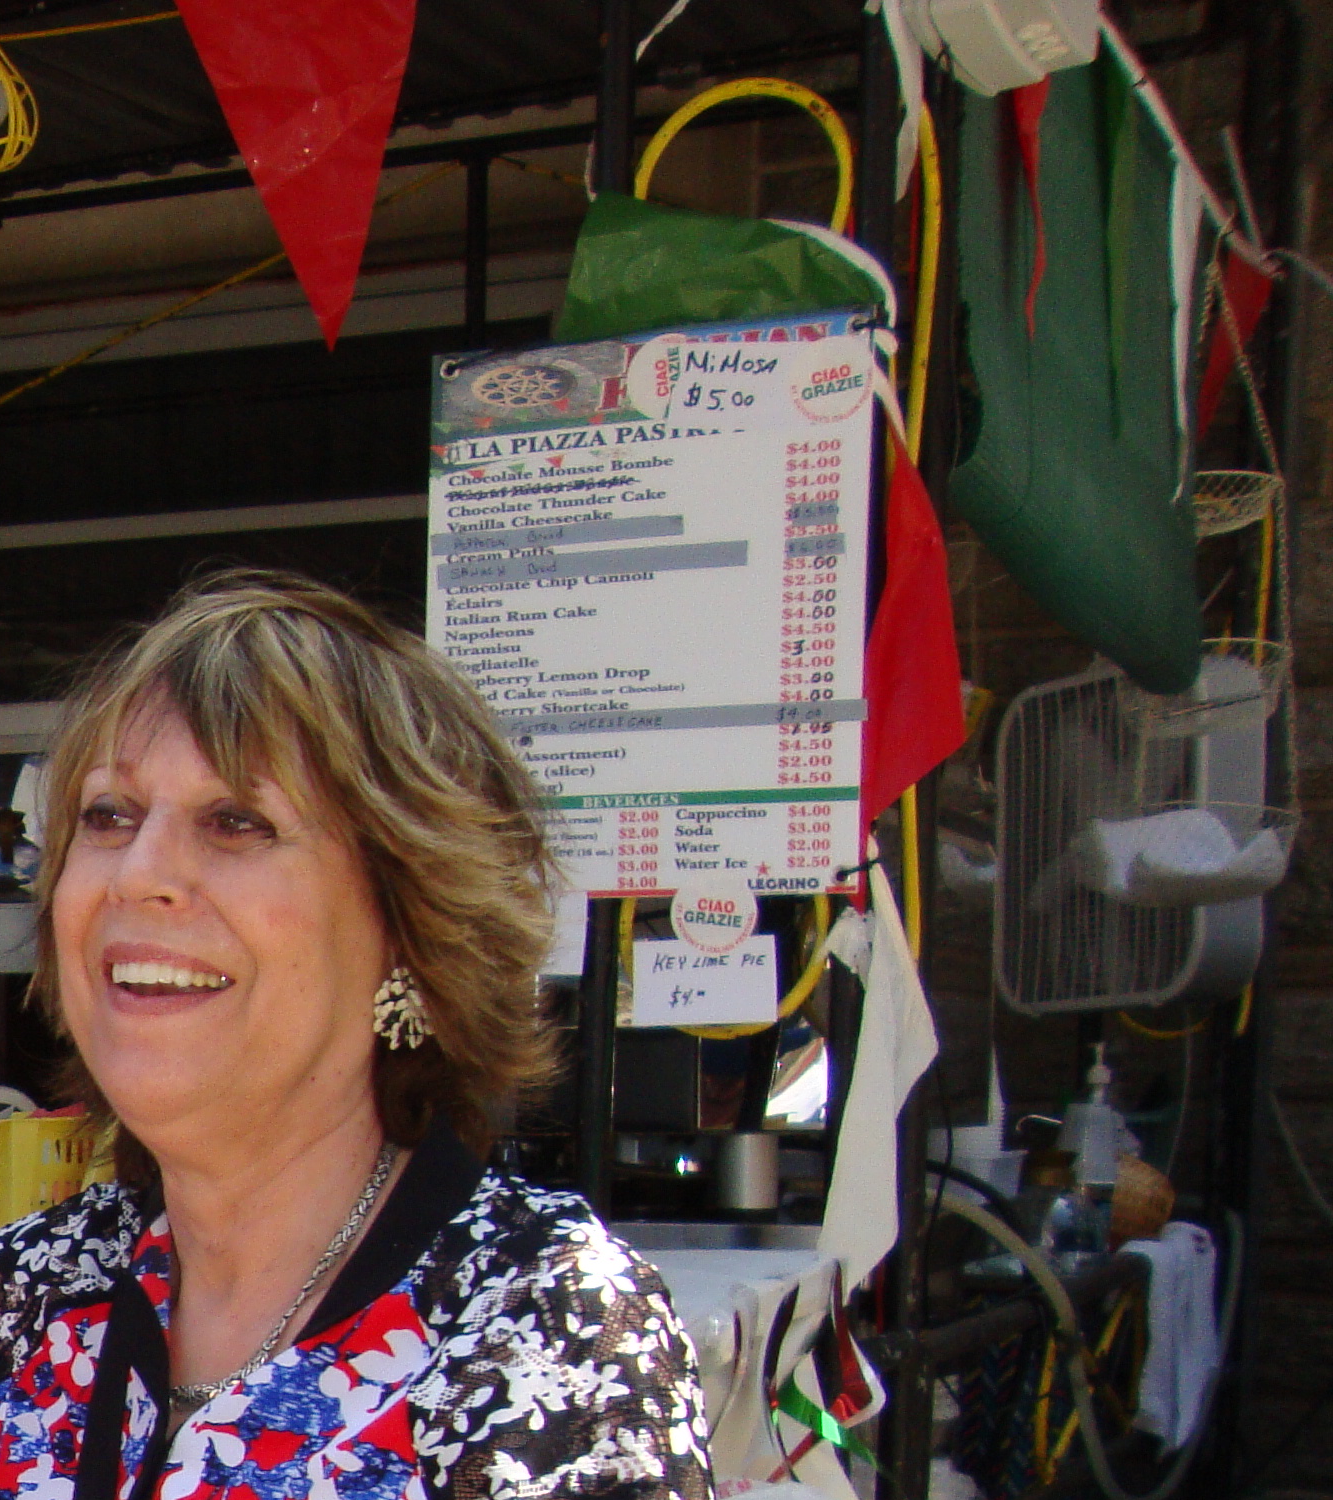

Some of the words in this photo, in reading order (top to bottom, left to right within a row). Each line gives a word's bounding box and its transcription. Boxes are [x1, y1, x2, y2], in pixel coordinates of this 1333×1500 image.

[654, 359, 669, 397] CIAO
[811, 364, 851, 384] CIAO
[801, 374, 864, 400] GRAZIE
[469, 440, 501, 459] LA
[510, 430, 607, 455] PIAZZA
[786, 439, 841, 455] $4.00
[448, 469, 533, 487] Chocolate
[538, 463, 605, 479] Mousse
[611, 456, 674, 472] Bombe
[786, 455, 841, 471] $4.00
[785, 472, 840, 488] $4.00
[447, 501, 533, 518] Chocolate
[538, 493, 616, 510] Thunder
[621, 488, 667, 502] Cake
[447, 519, 506, 534] Vanilla
[512, 509, 614, 528] Cheesecake
[447, 551, 502, 565] Cream
[447, 578, 531, 595] Chocolate
[537, 576, 579, 590] Chip
[585, 571, 655, 586] Cannoli
[783, 572, 837, 587] $2.50
[444, 612, 501, 626] Italian
[506, 610, 547, 622] Rum
[553, 605, 598, 619] Cake
[444, 628, 535, 644] Napoleons
[444, 644, 521, 657] Tiramisu
[781, 622, 836, 636] $4.50
[475, 675, 532, 689] pberry
[538, 671, 598, 683] Lemon
[605, 667, 651, 681] Drop
[780, 656, 835, 669] $4.00
[503, 688, 547, 701] Cake
[541, 699, 630, 714] Shortcake
[779, 738, 832, 752] $4.50
[544, 764, 595, 780] (slice)
[778, 755, 832, 769] $2.00
[777, 771, 832, 785] $4.50
[582, 793, 679, 809] BEVERAGES
[618, 810, 659, 823] $2.00
[676, 806, 767, 823] Cappuccino
[787, 805, 831, 817] $4.00
[618, 827, 659, 839] $2.00
[674, 824, 714, 837] Soda
[787, 822, 831, 834] $3.00
[618, 844, 659, 856] $3.00
[675, 841, 720, 853] Water
[787, 838, 831, 851] $2.00
[674, 858, 721, 870] Water
[724, 857, 748, 869] Ice
[786, 855, 831, 868] $2.50
[617, 876, 658, 889] $4.00
[697, 898, 735, 914] CIAO
[684, 911, 742, 928] GRAZIE
[652, 952, 686, 973] KEY
[692, 955, 730, 968] LIME
[741, 953, 767, 967] PIE
